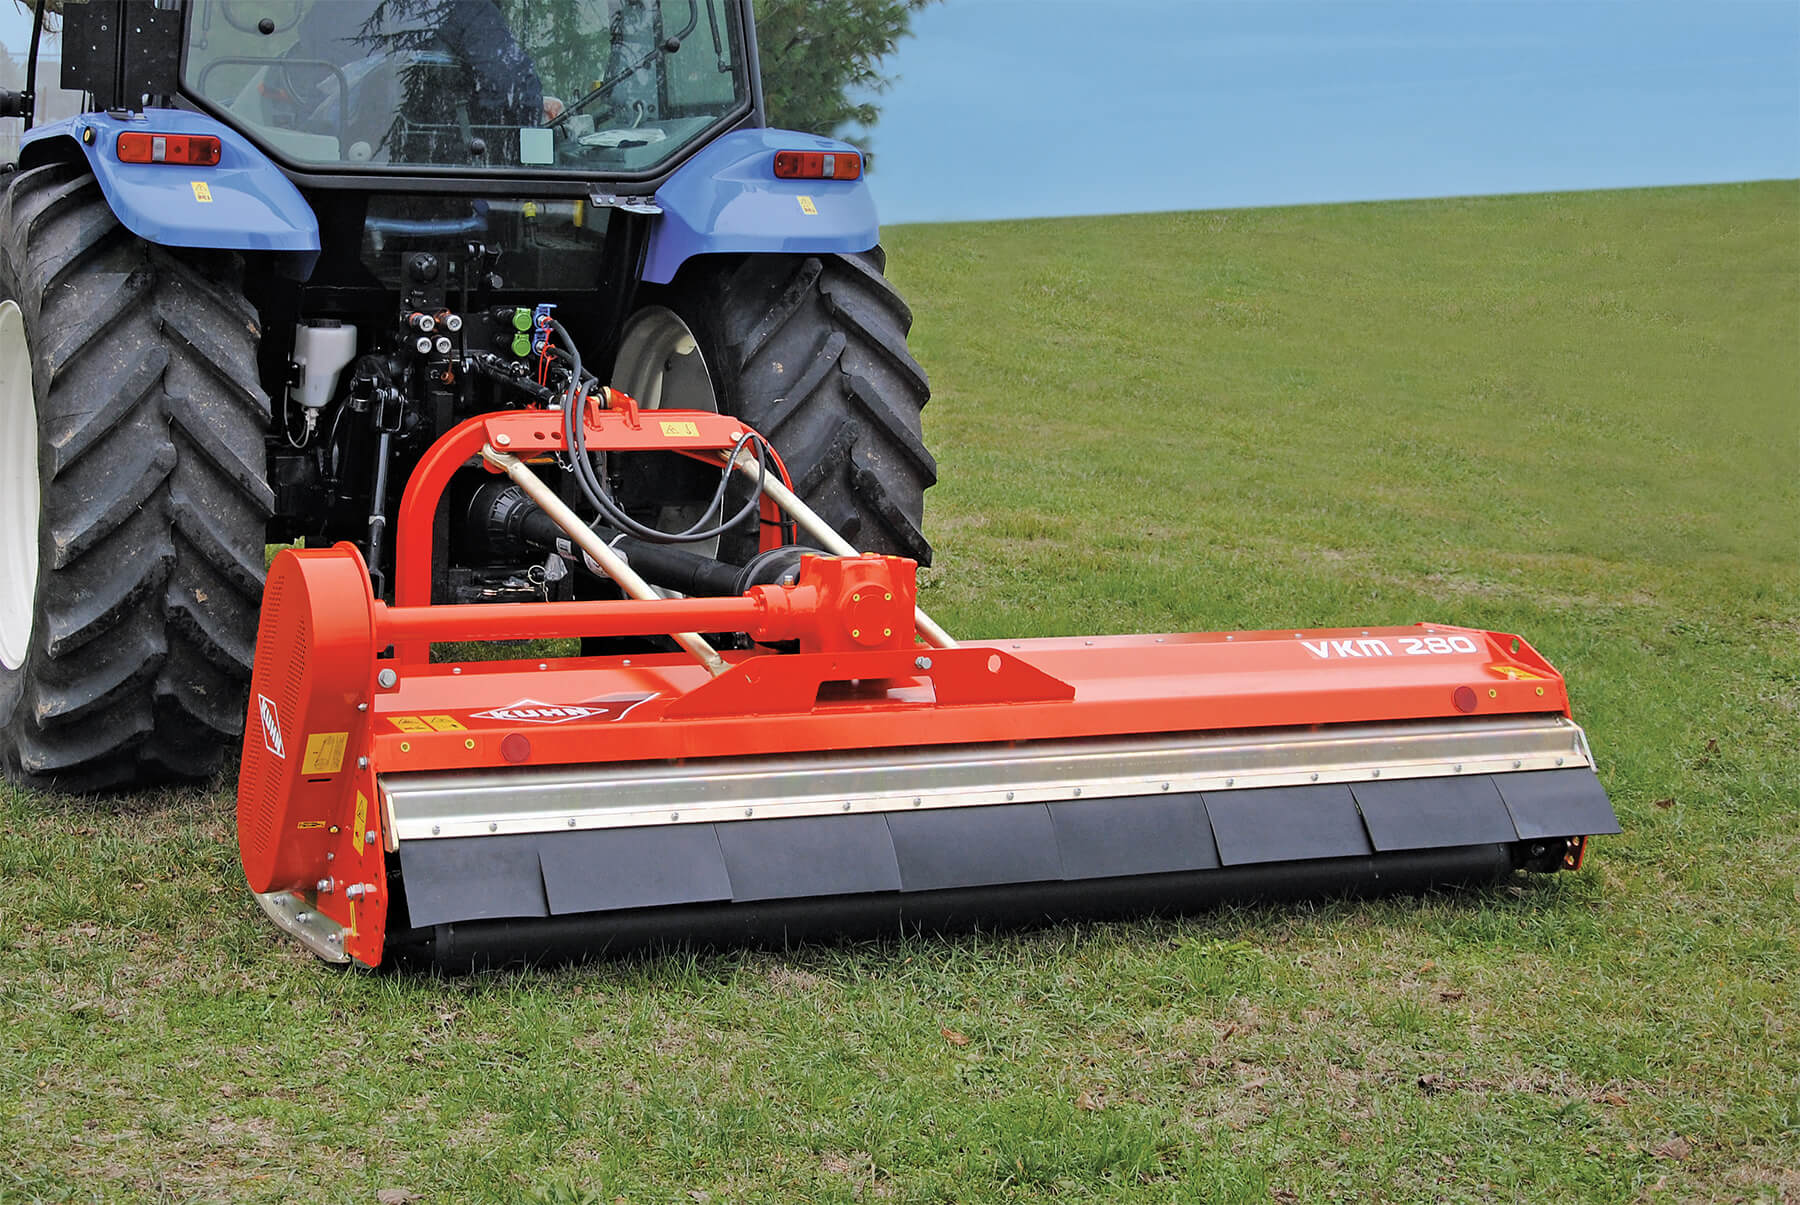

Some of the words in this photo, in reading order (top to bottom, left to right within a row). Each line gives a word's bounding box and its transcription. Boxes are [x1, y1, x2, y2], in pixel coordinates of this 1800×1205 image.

[1301, 639, 1393, 658] VKM
[1398, 636, 1477, 655] 280
[260, 696, 282, 753] KUHN
[488, 708, 591, 719] KUHN
